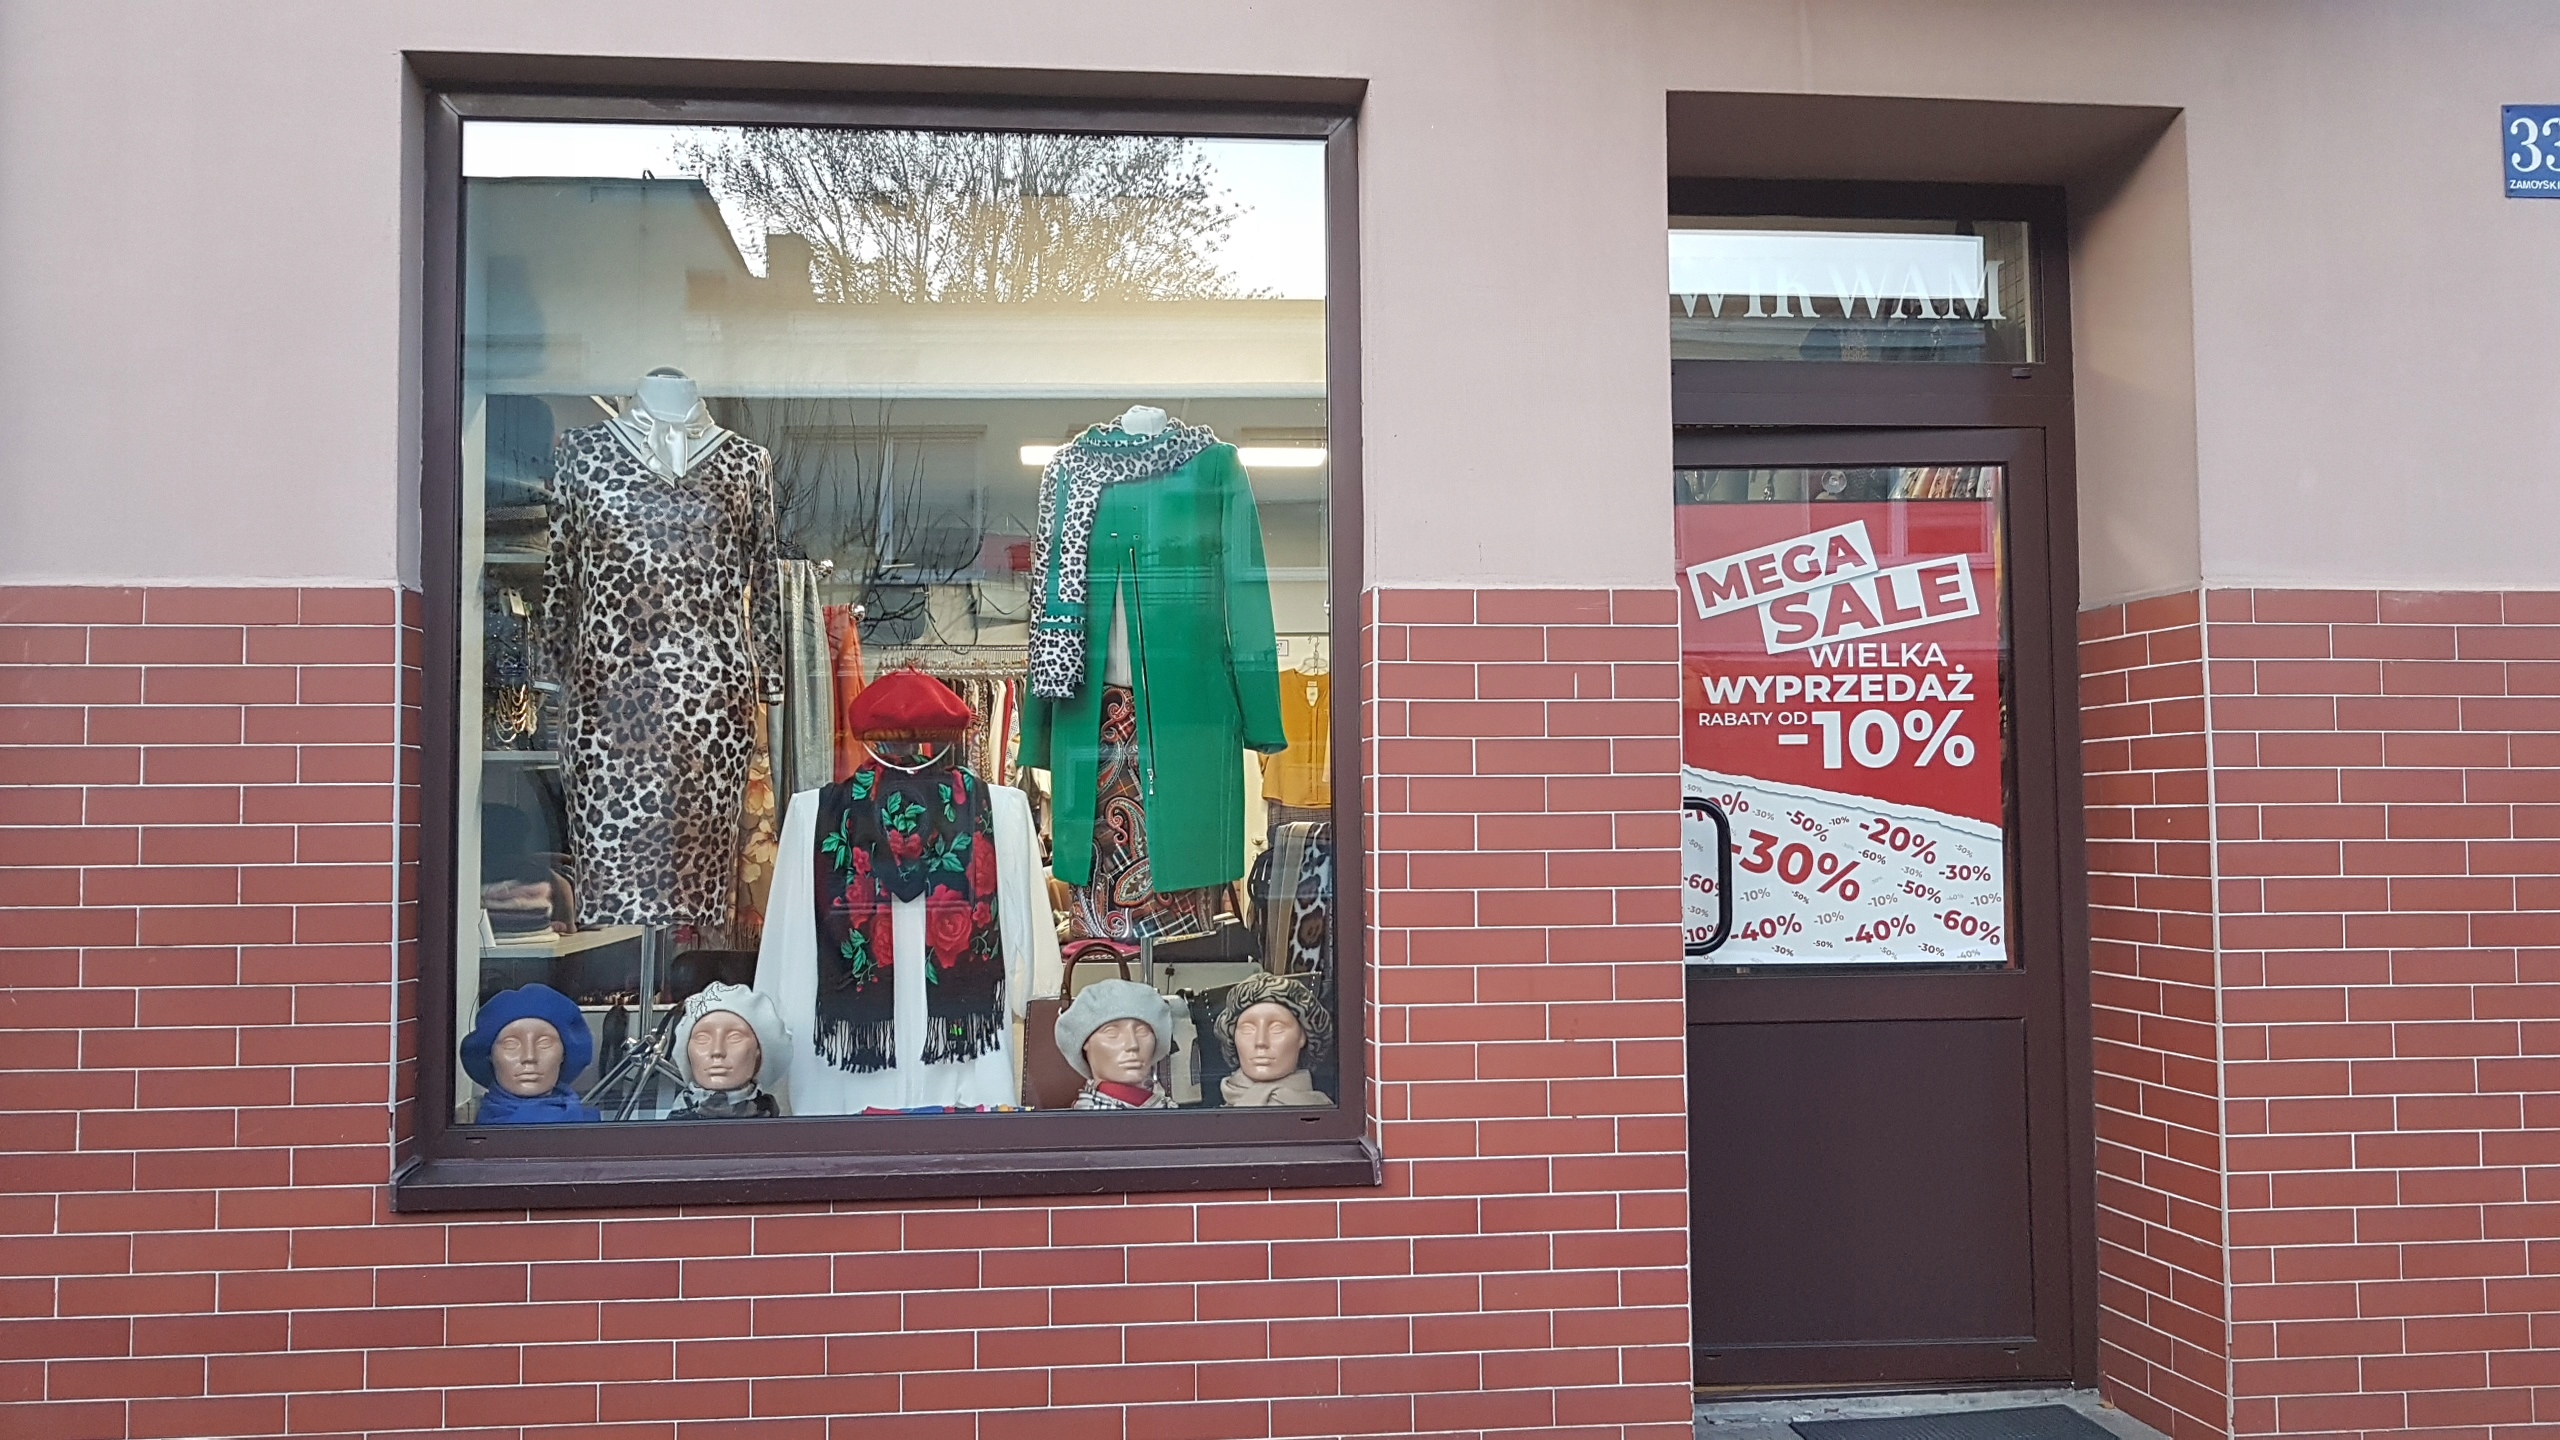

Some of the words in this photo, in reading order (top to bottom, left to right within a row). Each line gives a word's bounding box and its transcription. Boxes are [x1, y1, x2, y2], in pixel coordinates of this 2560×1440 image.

[1696, 534, 1867, 609] MEGA
[1769, 563, 1969, 645] SALE
[1808, 643, 1947, 668] WIELKA
[1702, 664, 1975, 704] WYPRZEDAŻ
[1699, 712, 1773, 726] RABATY
[1778, 712, 1808, 726] OD
[1778, 709, 1975, 769] -10%
[1752, 809, 1775, 821] -30%
[1828, 816, 1850, 826] -10%
[1786, 810, 1829, 842] -50%
[1859, 818, 1938, 865] -20%
[1858, 849, 1886, 865] -60%
[1731, 829, 1861, 902] -30%
[1900, 866, 1923, 878] -30%
[1938, 865, 1991, 881] -30%
[1740, 888, 1770, 901] -10%
[1791, 890, 1810, 905] -50%
[1896, 880, 1941, 904] -50%
[1970, 892, 2002, 907] -10%
[1867, 893, 1898, 907] -10%
[1687, 905, 1709, 918] -30%
[1814, 910, 1844, 925] -10%
[1730, 913, 1802, 941] -40%
[1844, 914, 1916, 943] -40%
[1933, 909, 2001, 945] -60%
[1771, 945, 1794, 957] -30%
[1812, 940, 1833, 948] -50%
[1917, 942, 1945, 957] -30%
